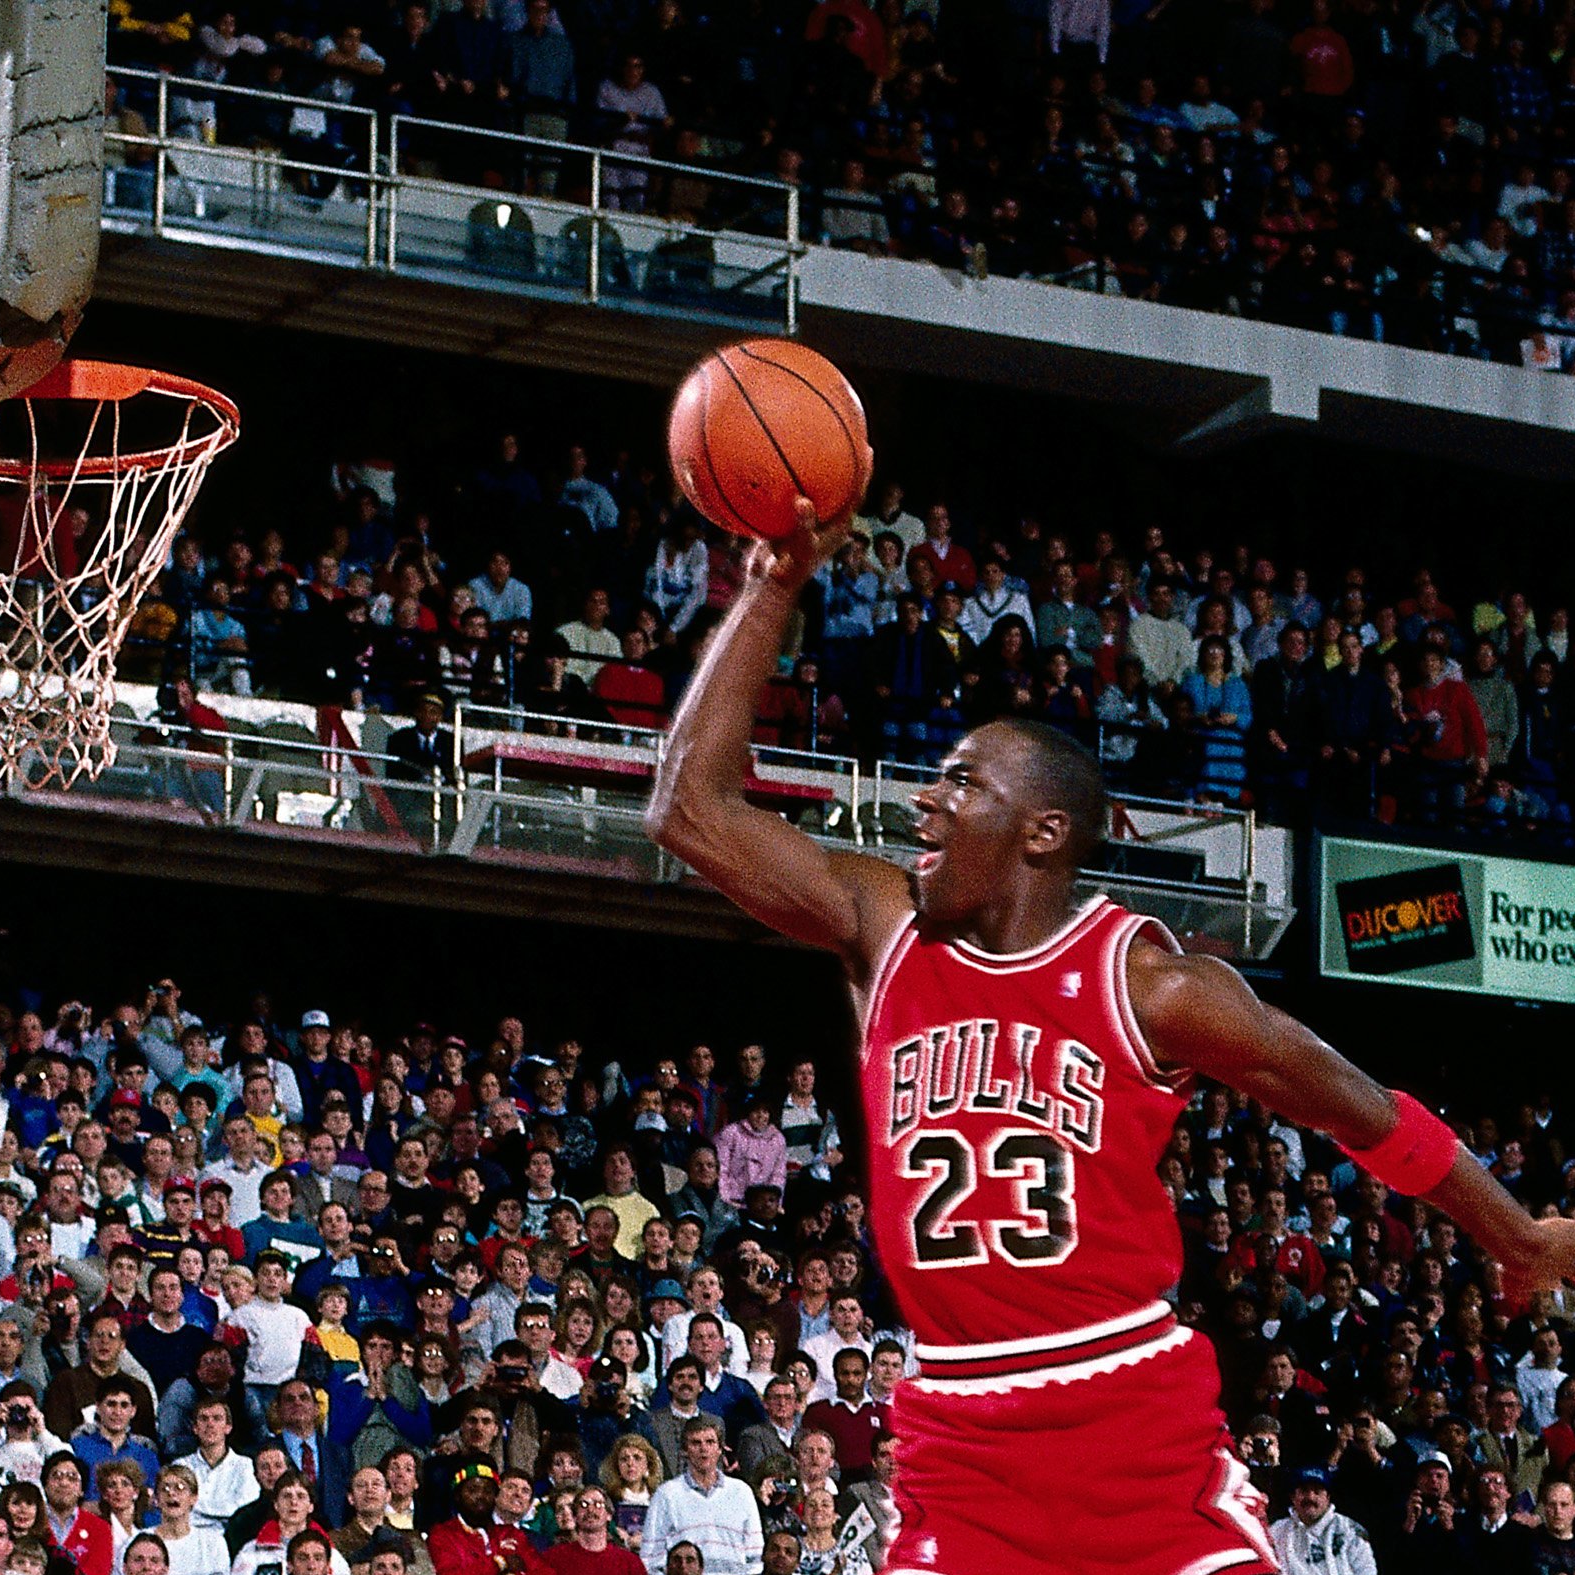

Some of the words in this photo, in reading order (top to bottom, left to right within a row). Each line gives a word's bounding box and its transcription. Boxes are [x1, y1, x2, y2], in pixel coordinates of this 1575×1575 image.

[1345, 891, 1463, 942] DISCOVER
[1489, 891, 1534, 928] For
[1490, 930, 1547, 965] who
[886, 1017, 1107, 1155] BULLS
[896, 1127, 1080, 1270] 23
